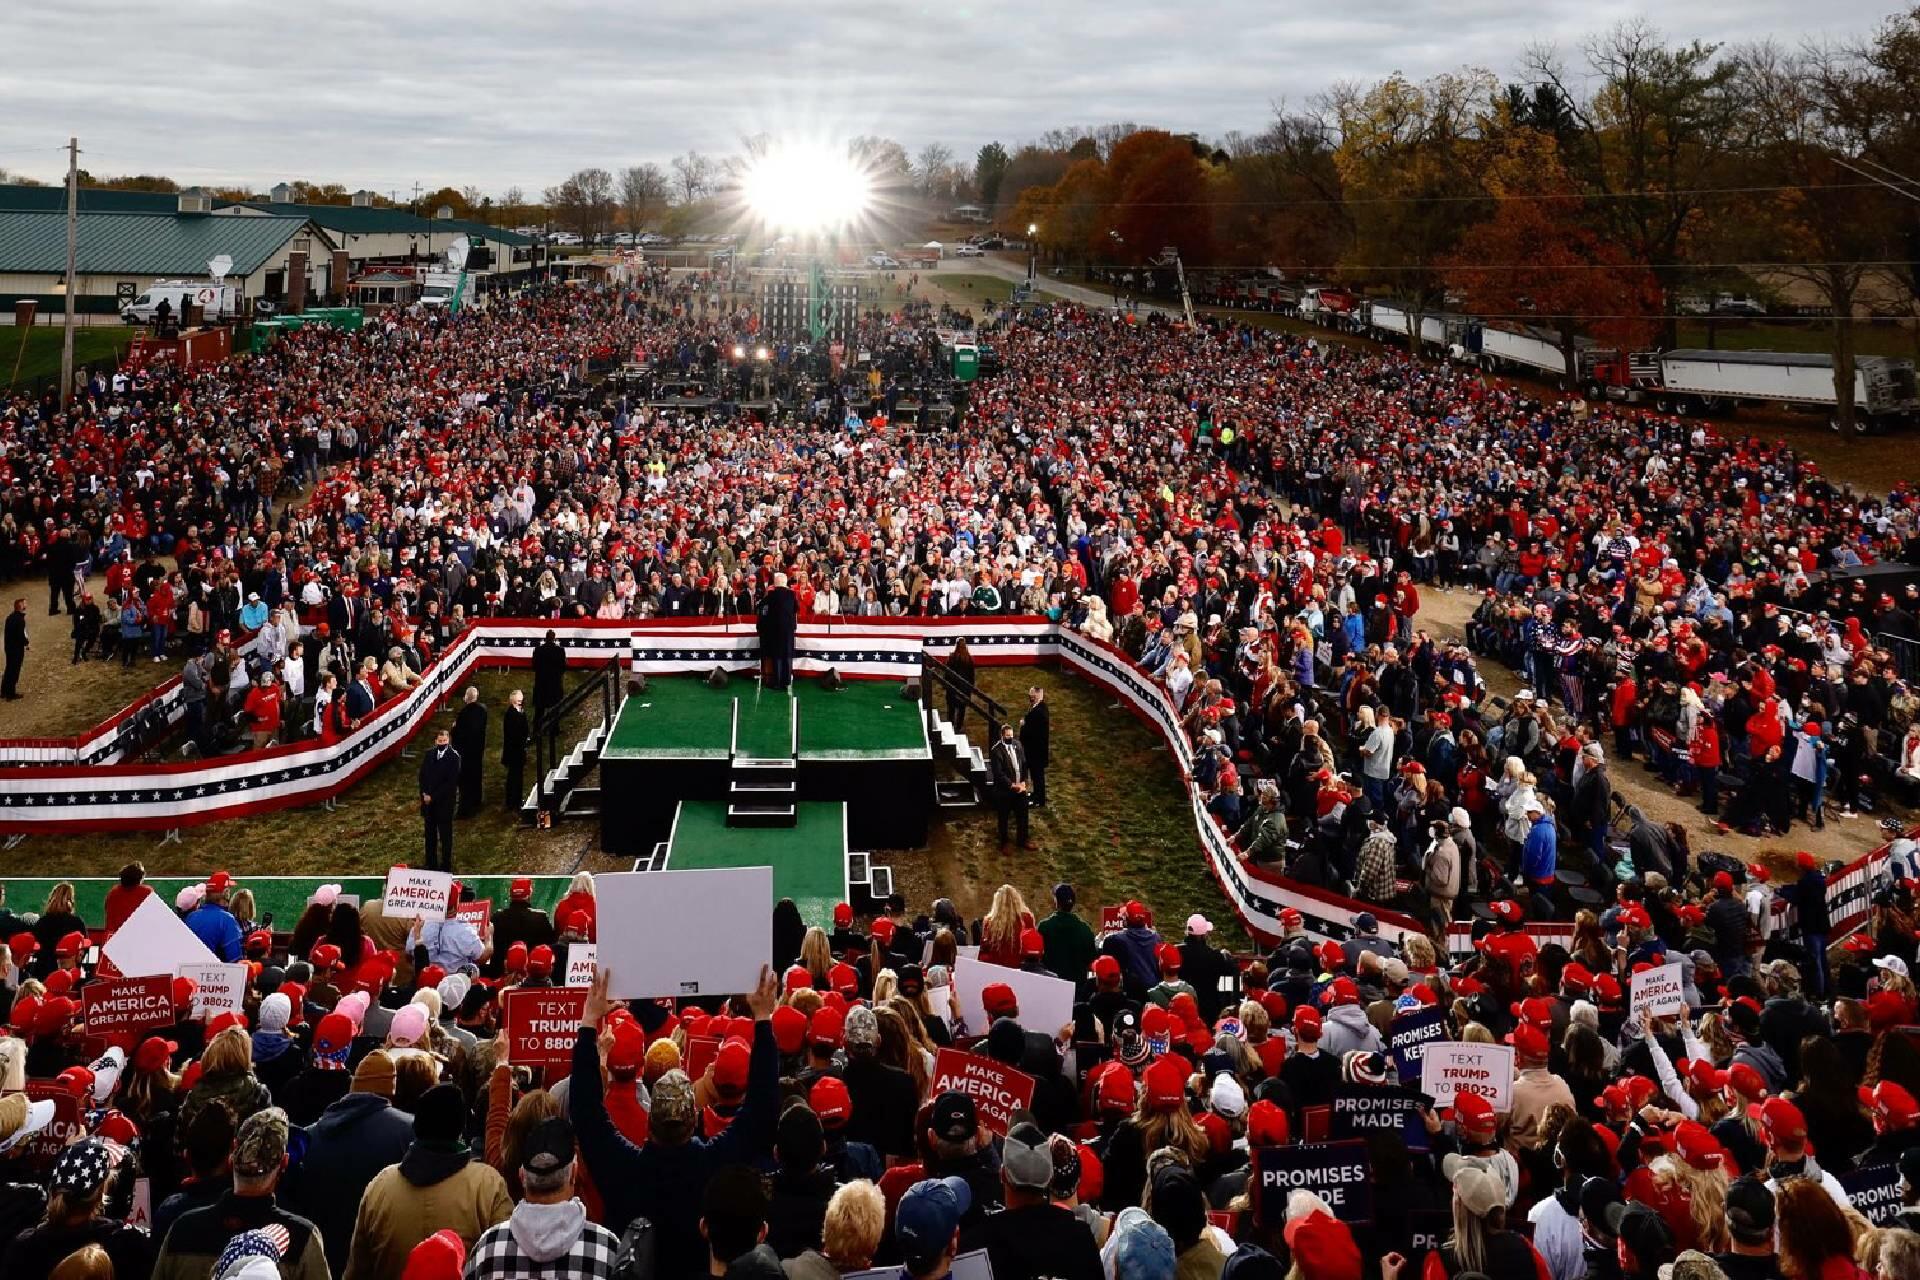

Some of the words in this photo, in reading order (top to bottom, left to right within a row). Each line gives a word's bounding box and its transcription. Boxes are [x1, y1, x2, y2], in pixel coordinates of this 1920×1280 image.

[408, 878, 432, 886] MAKE
[390, 886, 445, 900] AMERICA
[387, 899, 416, 909] GREAT
[418, 902, 444, 912] AGAIN
[455, 911, 484, 921] MORE
[200, 972, 226, 982] TEXT
[569, 975, 593, 983] GREA
[1645, 974, 1665, 985] MAKE
[111, 985, 146, 997] MAKE
[1634, 982, 1680, 1002] AMERICA
[89, 995, 169, 1015] AMERICA
[202, 996, 234, 1008] 88022
[1657, 995, 1681, 1006] AGAIN
[537, 1002, 577, 1015] TEXT
[89, 1013, 128, 1026] GREAT
[132, 1009, 171, 1022] AGAIN
[1391, 1022, 1442, 1049] PROMISES
[519, 1037, 540, 1050] TO
[544, 1037, 578, 1050] 880
[1403, 1045, 1425, 1062] KEP
[1450, 1054, 1483, 1066] TEXT
[965, 1063, 1004, 1085] MAKE
[1443, 1069, 1490, 1080] TRUMP
[936, 1074, 1022, 1110] AMERICA
[1434, 1083, 1450, 1094] TO
[1454, 1082, 1497, 1099] 88022
[981, 1102, 1008, 1123] AGA
[1352, 1113, 1404, 1128] MADE
[1263, 1164, 1365, 1187] PROMISES
[1847, 1183, 1903, 1207] PROMIS
[1867, 1202, 1904, 1222] MAD
